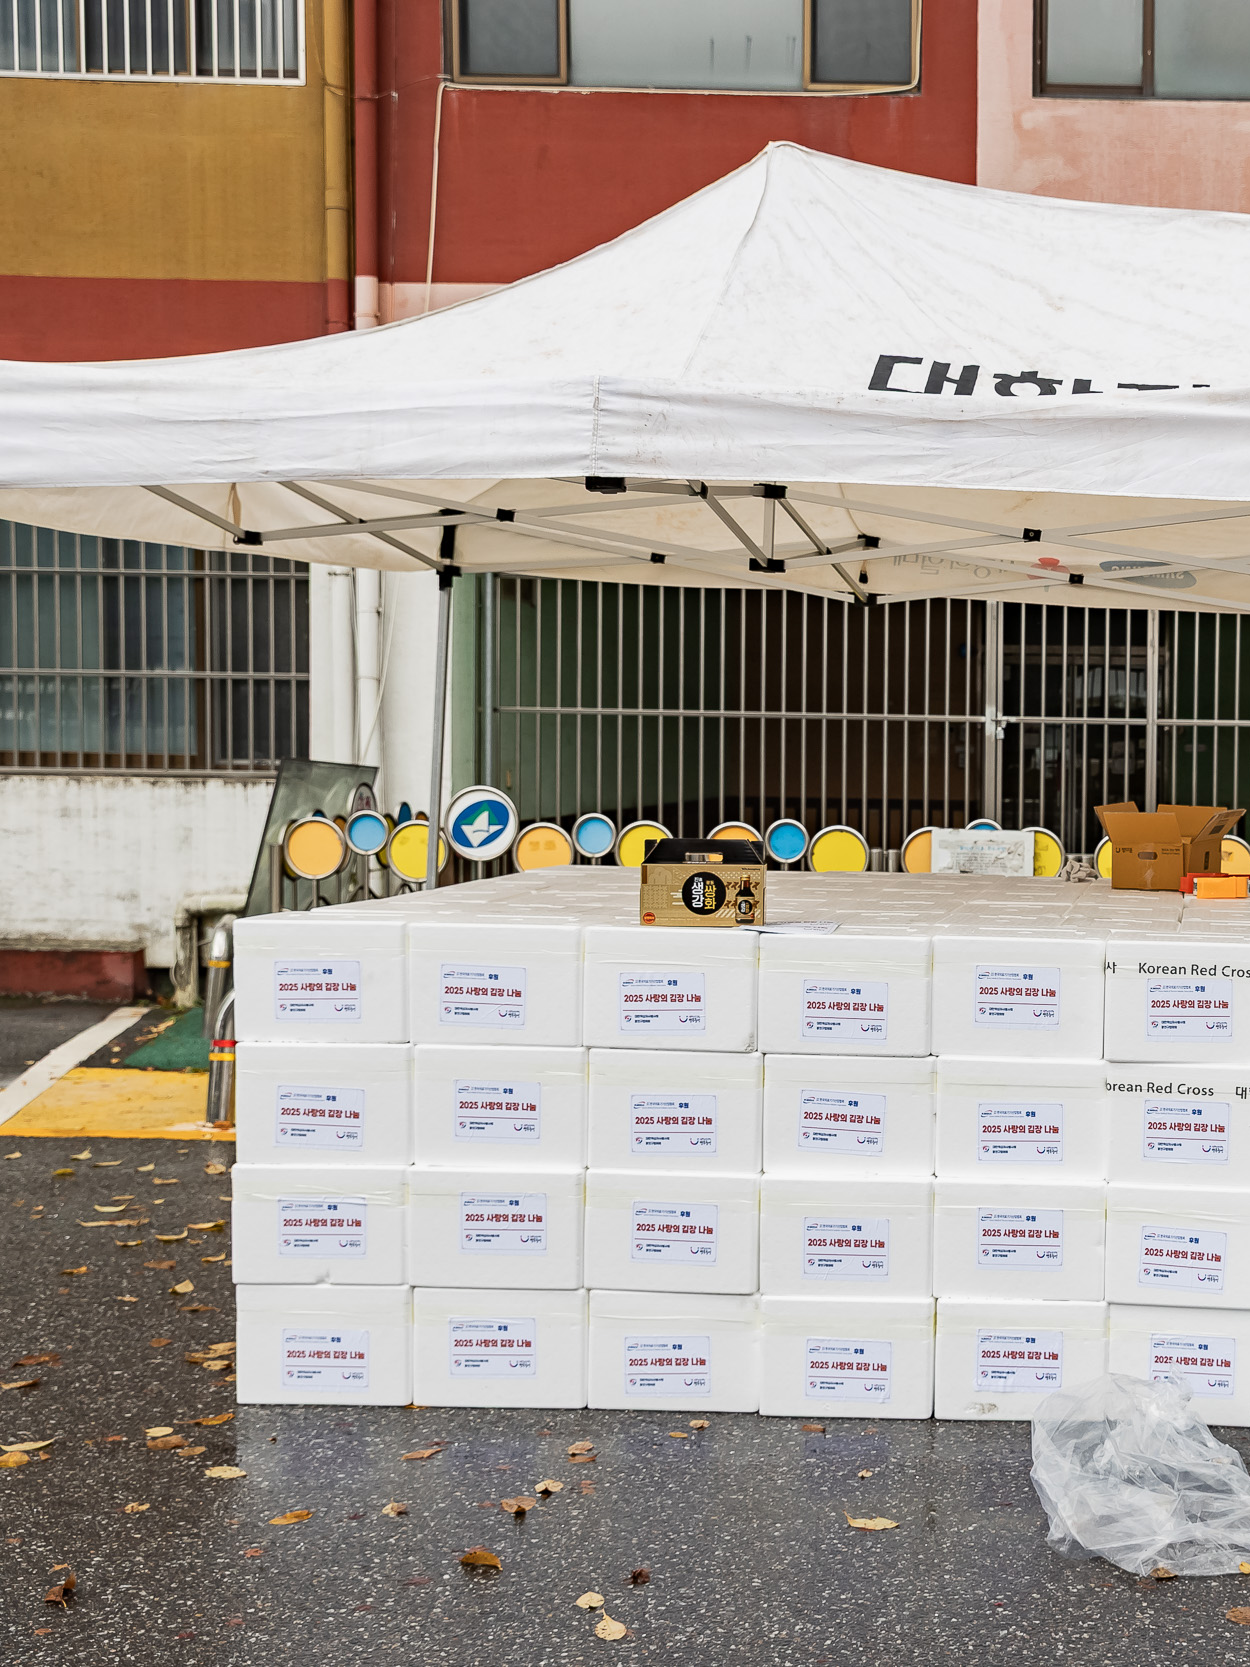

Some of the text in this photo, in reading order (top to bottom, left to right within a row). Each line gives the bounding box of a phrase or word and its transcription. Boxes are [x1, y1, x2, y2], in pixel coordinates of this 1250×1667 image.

[691, 881, 705, 908] 생강
[704, 884, 717, 910] 쌍화
[1138, 962, 1187, 975] Korean
[1191, 963, 1217, 976] Red
[279, 982, 357, 992] 2025 사랑의 김장 나눔
[444, 986, 522, 998] 2025 사랑의 김장 나눔
[979, 986, 1056, 997] 2025 사랑의 김장 나눔
[623, 993, 702, 1003] 2025 사랑의 김장 나눔
[807, 1001, 885, 1013] 2025 사랑의 김장 나눔
[1151, 999, 1229, 1009] 2025 사랑의 김장 나눔
[1146, 1082, 1172, 1094] Red
[1177, 1083, 1214, 1097] Cross
[459, 1101, 537, 1112] 2025 사랑의 김장 나눔
[281, 1107, 360, 1120] 2025 사랑의 김장 나눔
[803, 1111, 881, 1125] 2025 사랑의 김장 나눔
[635, 1116, 713, 1126] 2025 사랑의 김장 나눔
[982, 1124, 1060, 1134] 2025 사랑의 김장 나눔
[1148, 1121, 1225, 1134] 2025 사랑의 김장 나눔
[283, 1218, 362, 1228] 2025 사랑의 김장 나눔
[465, 1213, 543, 1223] 2025 사랑의 김장 나눔
[636, 1223, 714, 1235] 2025 사랑의 김장 나눔
[982, 1228, 1060, 1239] 2025 사랑의 김장 나눔
[807, 1238, 885, 1249] 2025 사랑의 김장 나눔
[1144, 1247, 1222, 1263] 2025 사랑의 김장 나눔
[454, 1338, 532, 1348] 2025 사랑의 김장 나눔
[287, 1350, 365, 1360] 2025 사랑의 김장 나눔
[981, 1351, 1059, 1361] 2025 사랑의 김장 나눔
[629, 1357, 707, 1367] 2025 사랑의 김장 나눔
[810, 1360, 887, 1372] 2025 사랑의 김장 나눔
[1175, 1357, 1198, 1366] 사랑의
[1199, 1357, 1214, 1367] 김장
[1215, 1359, 1231, 1368] 나눔
